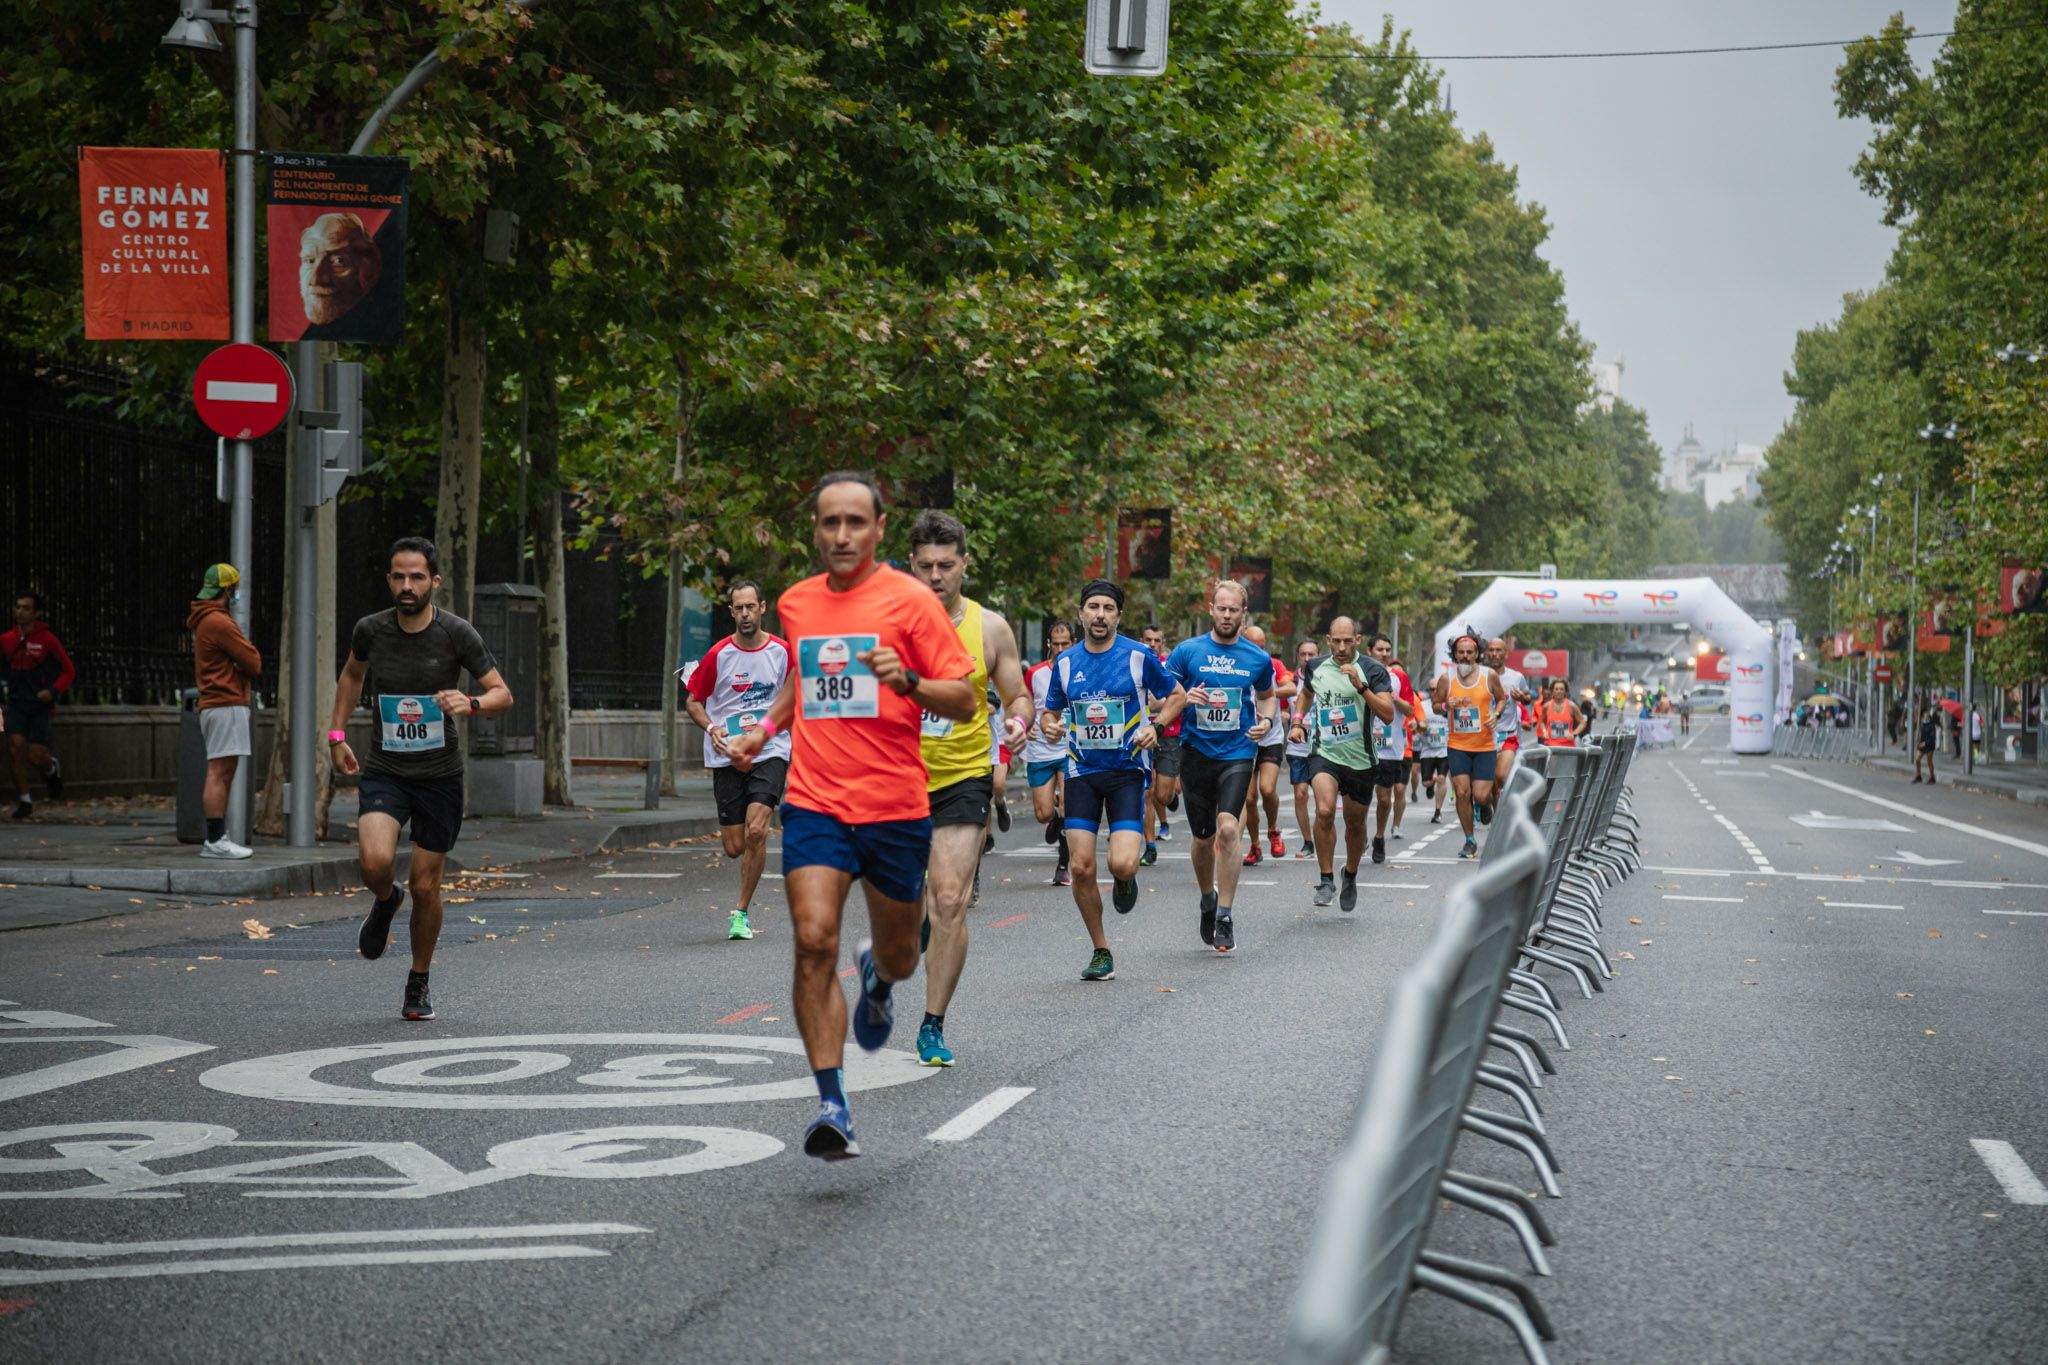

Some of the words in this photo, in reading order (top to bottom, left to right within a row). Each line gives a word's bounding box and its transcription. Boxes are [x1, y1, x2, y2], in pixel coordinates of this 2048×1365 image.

[273, 155, 285, 165] 28
[305, 157, 315, 166] 31
[273, 170, 336, 180] CENTENARIO
[273, 180, 292, 189] DEL
[294, 182, 354, 192] NACIMIENTO
[357, 184, 369, 193] DE
[97, 182, 209, 206] FERNÁN
[273, 191, 327, 201] FERNANDO
[98, 205, 210, 230] GÓMEZ
[122, 234, 189, 246] CENTRO
[112, 248, 200, 260] CULTURAL
[100, 263, 122, 274] DE
[131, 263, 152, 274] LA
[161, 264, 211, 275] VILLA
[140, 321, 193, 332] MADRID
[816, 676, 854, 701] 389
[1080, 689, 1107, 699] CLUB
[1207, 709, 1231, 722] 402
[396, 723, 428, 740] 408
[1084, 725, 1114, 740] 1231
[1331, 724, 1350, 737] 415
